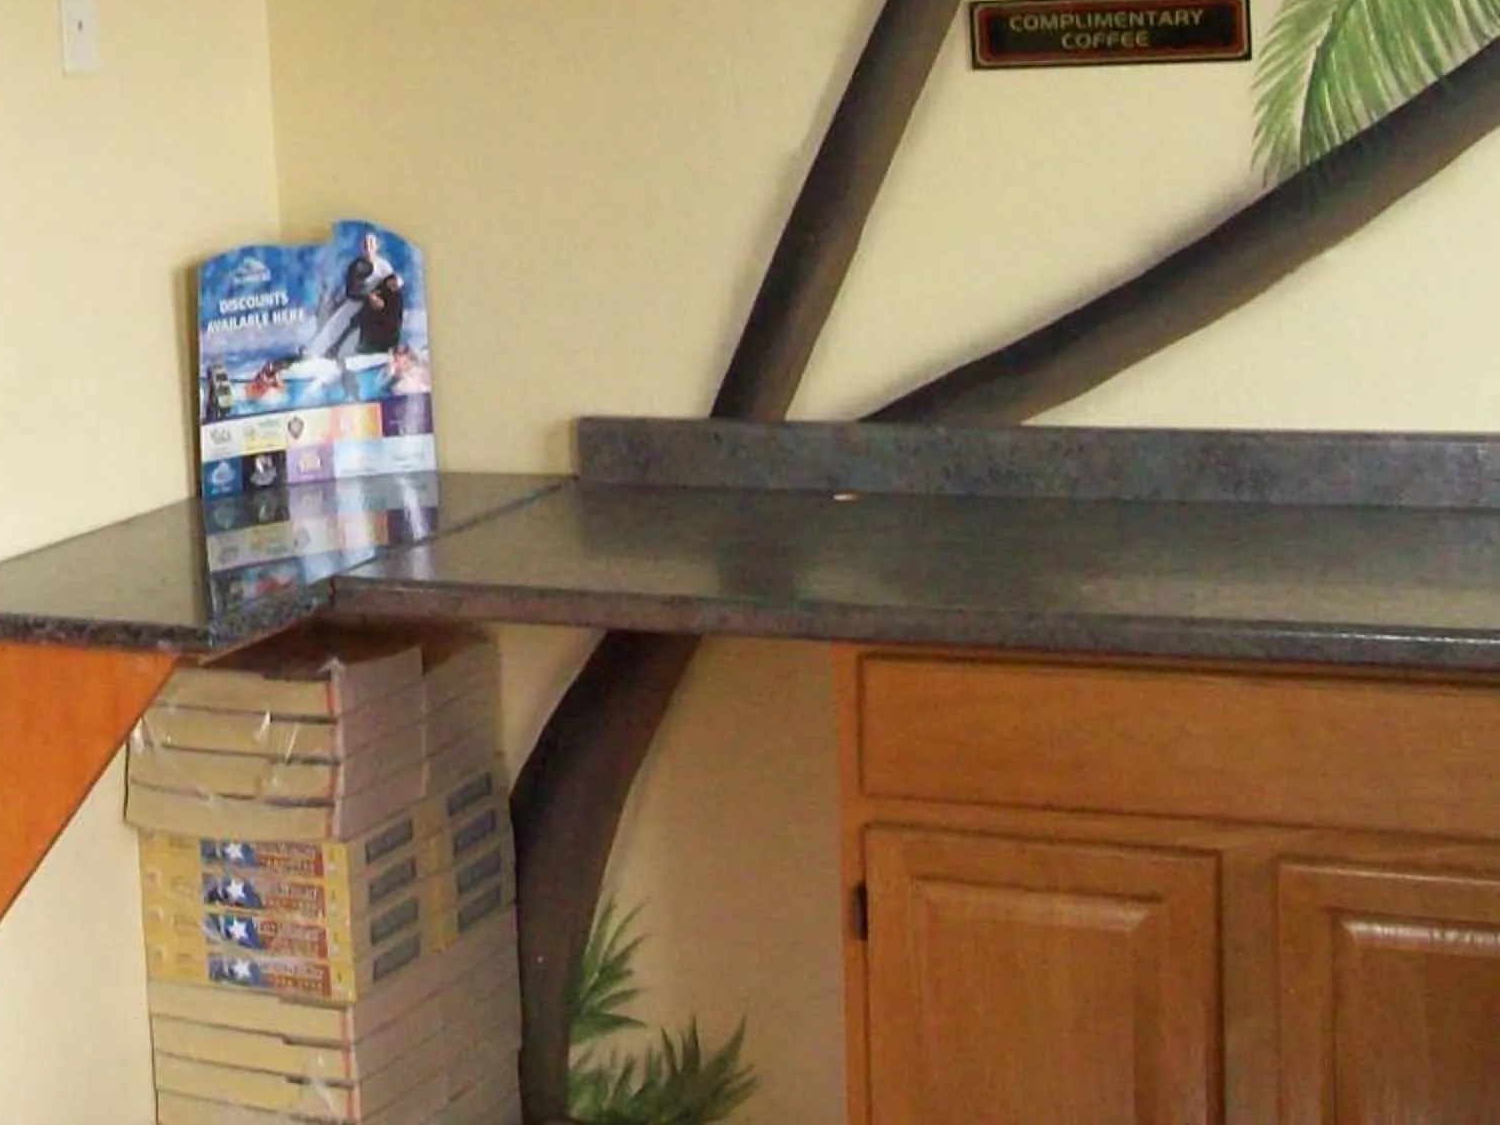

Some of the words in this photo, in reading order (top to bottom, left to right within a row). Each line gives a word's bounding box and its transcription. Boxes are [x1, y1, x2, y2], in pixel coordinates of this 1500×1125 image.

[1008, 8, 1205, 32] COMPLIMENTARY
[1061, 29, 1150, 51] COFFEE
[219, 289, 289, 315] DISCOUNTS
[207, 311, 270, 334] AVAILABLE
